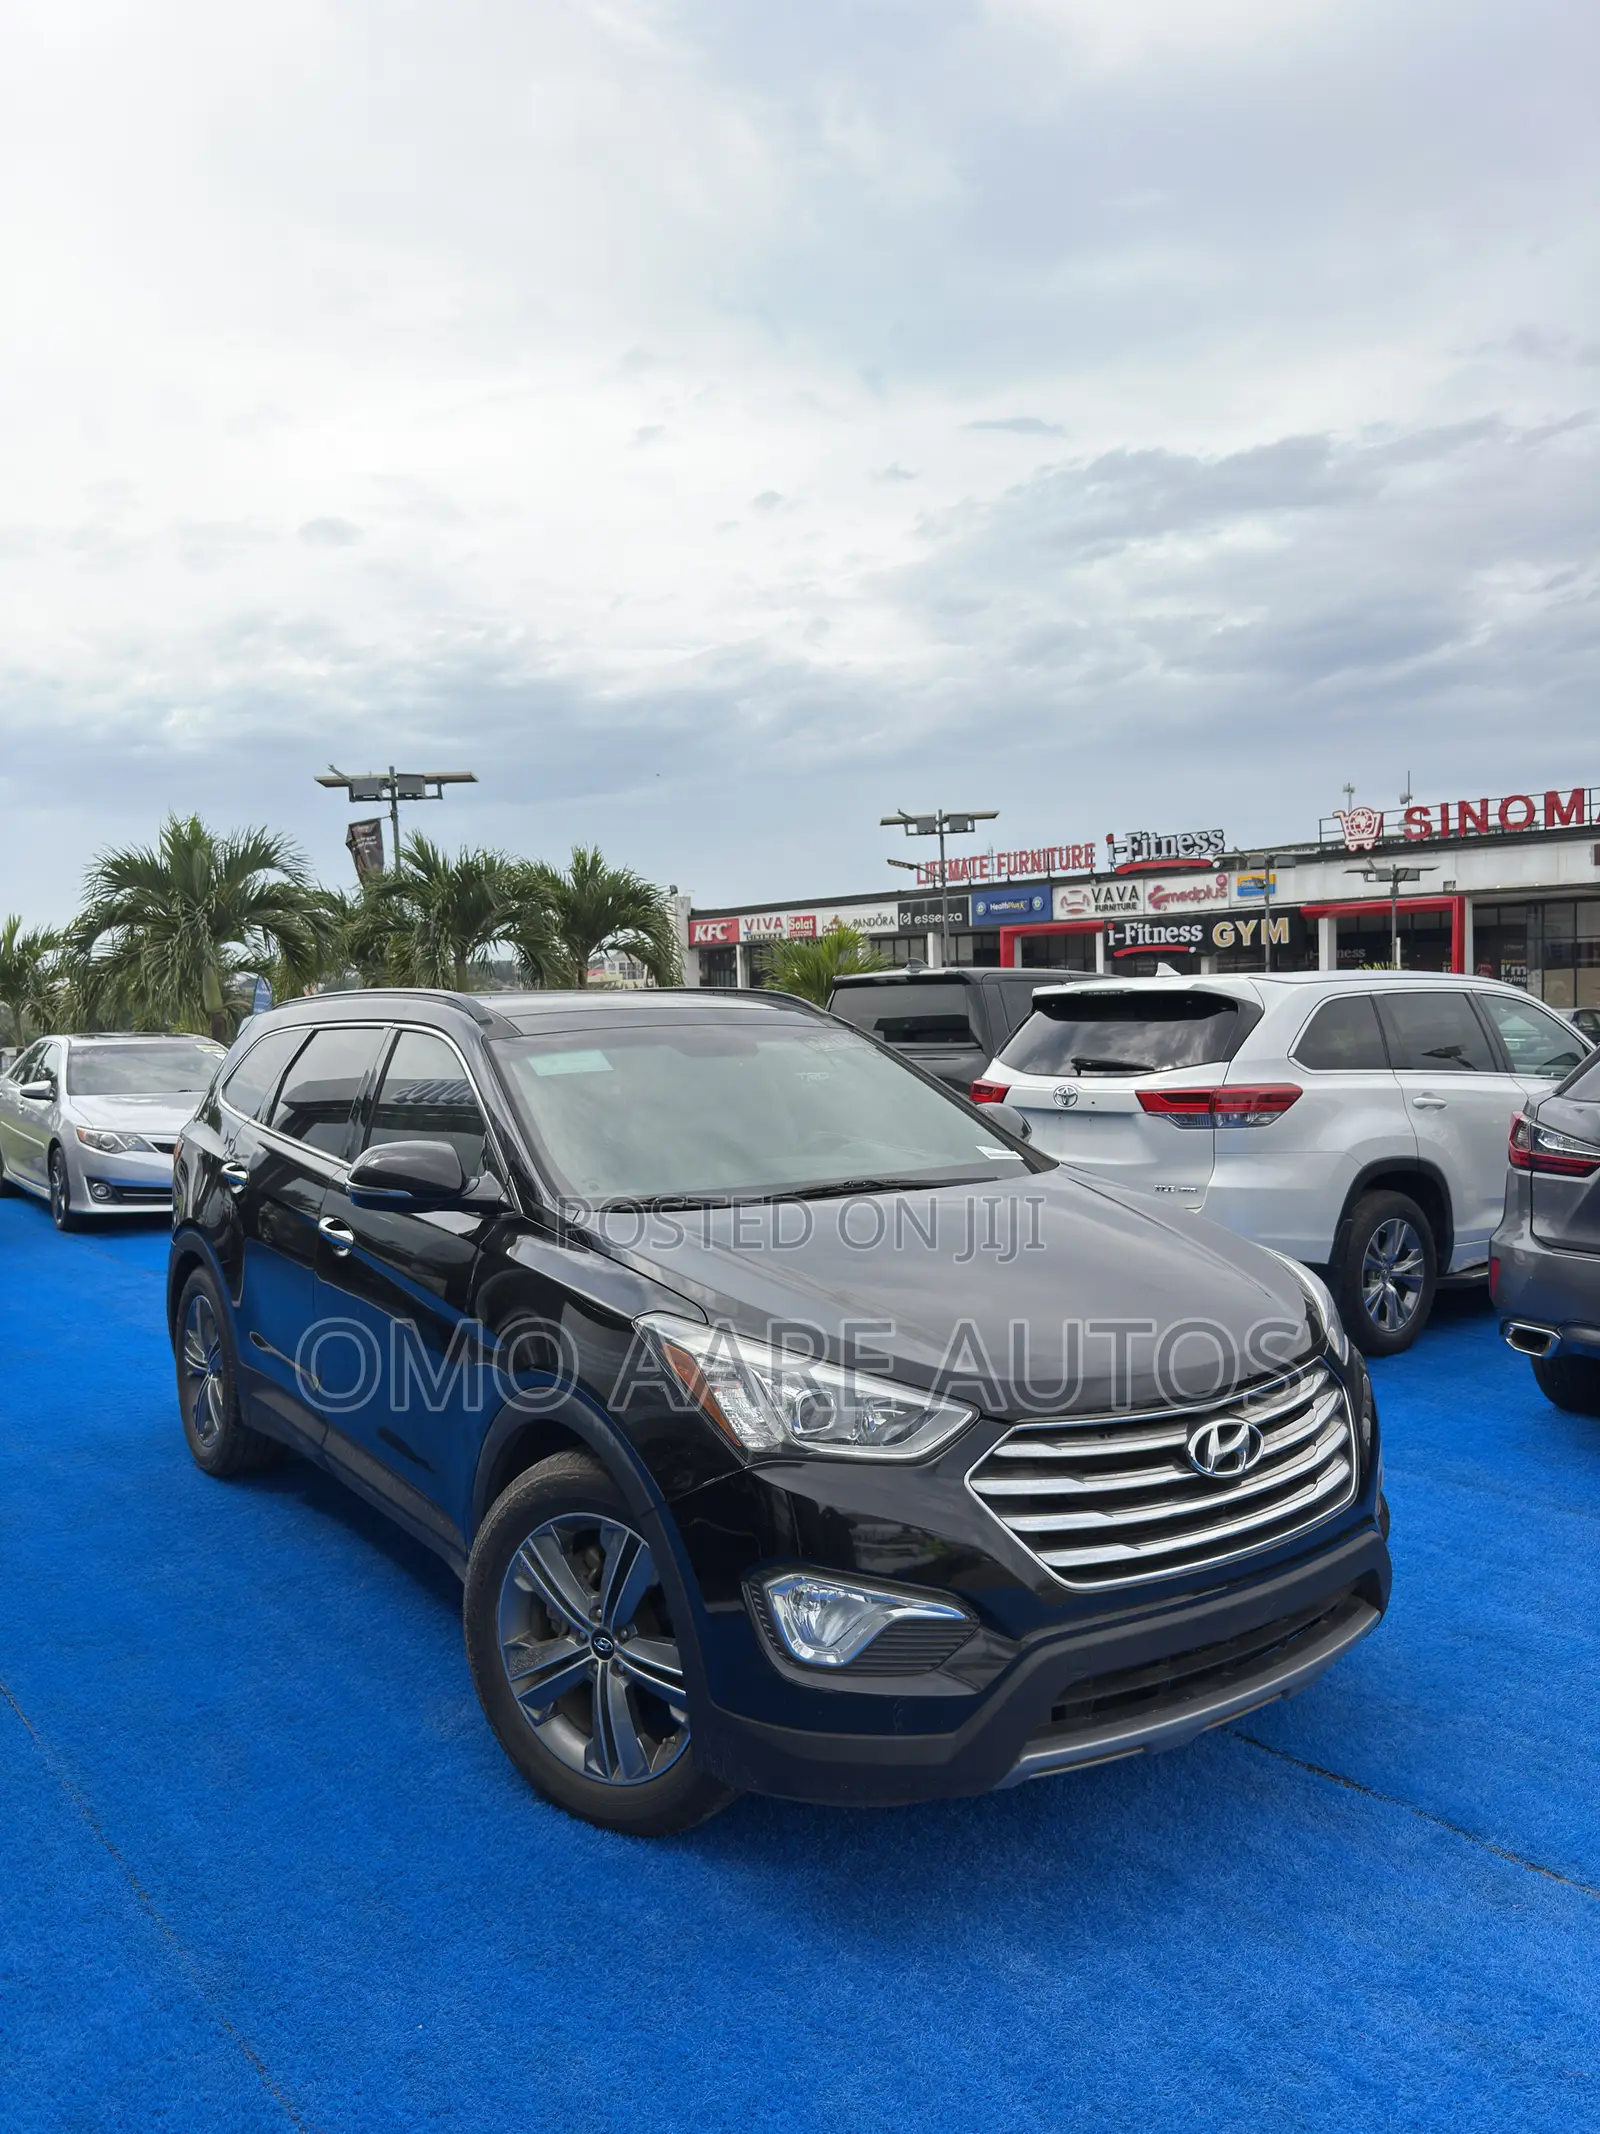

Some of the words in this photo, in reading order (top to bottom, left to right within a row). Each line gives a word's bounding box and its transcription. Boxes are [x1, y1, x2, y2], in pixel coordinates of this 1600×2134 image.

[1404, 788, 1600, 840] SINOM
[1106, 830, 1225, 863] i-Fitness
[996, 843, 1096, 877] FURNITURE
[1091, 885, 1139, 903] VAVA
[1168, 885, 1227, 903] medplus
[1095, 902, 1137, 912] FURNITURE
[695, 922, 728, 942] KFC
[744, 917, 783, 930] VIVA
[789, 917, 813, 930] Solat
[1107, 922, 1203, 946] i-Fitness
[1212, 917, 1289, 948] GYM
[1501, 964, 1527, 975] I'm
